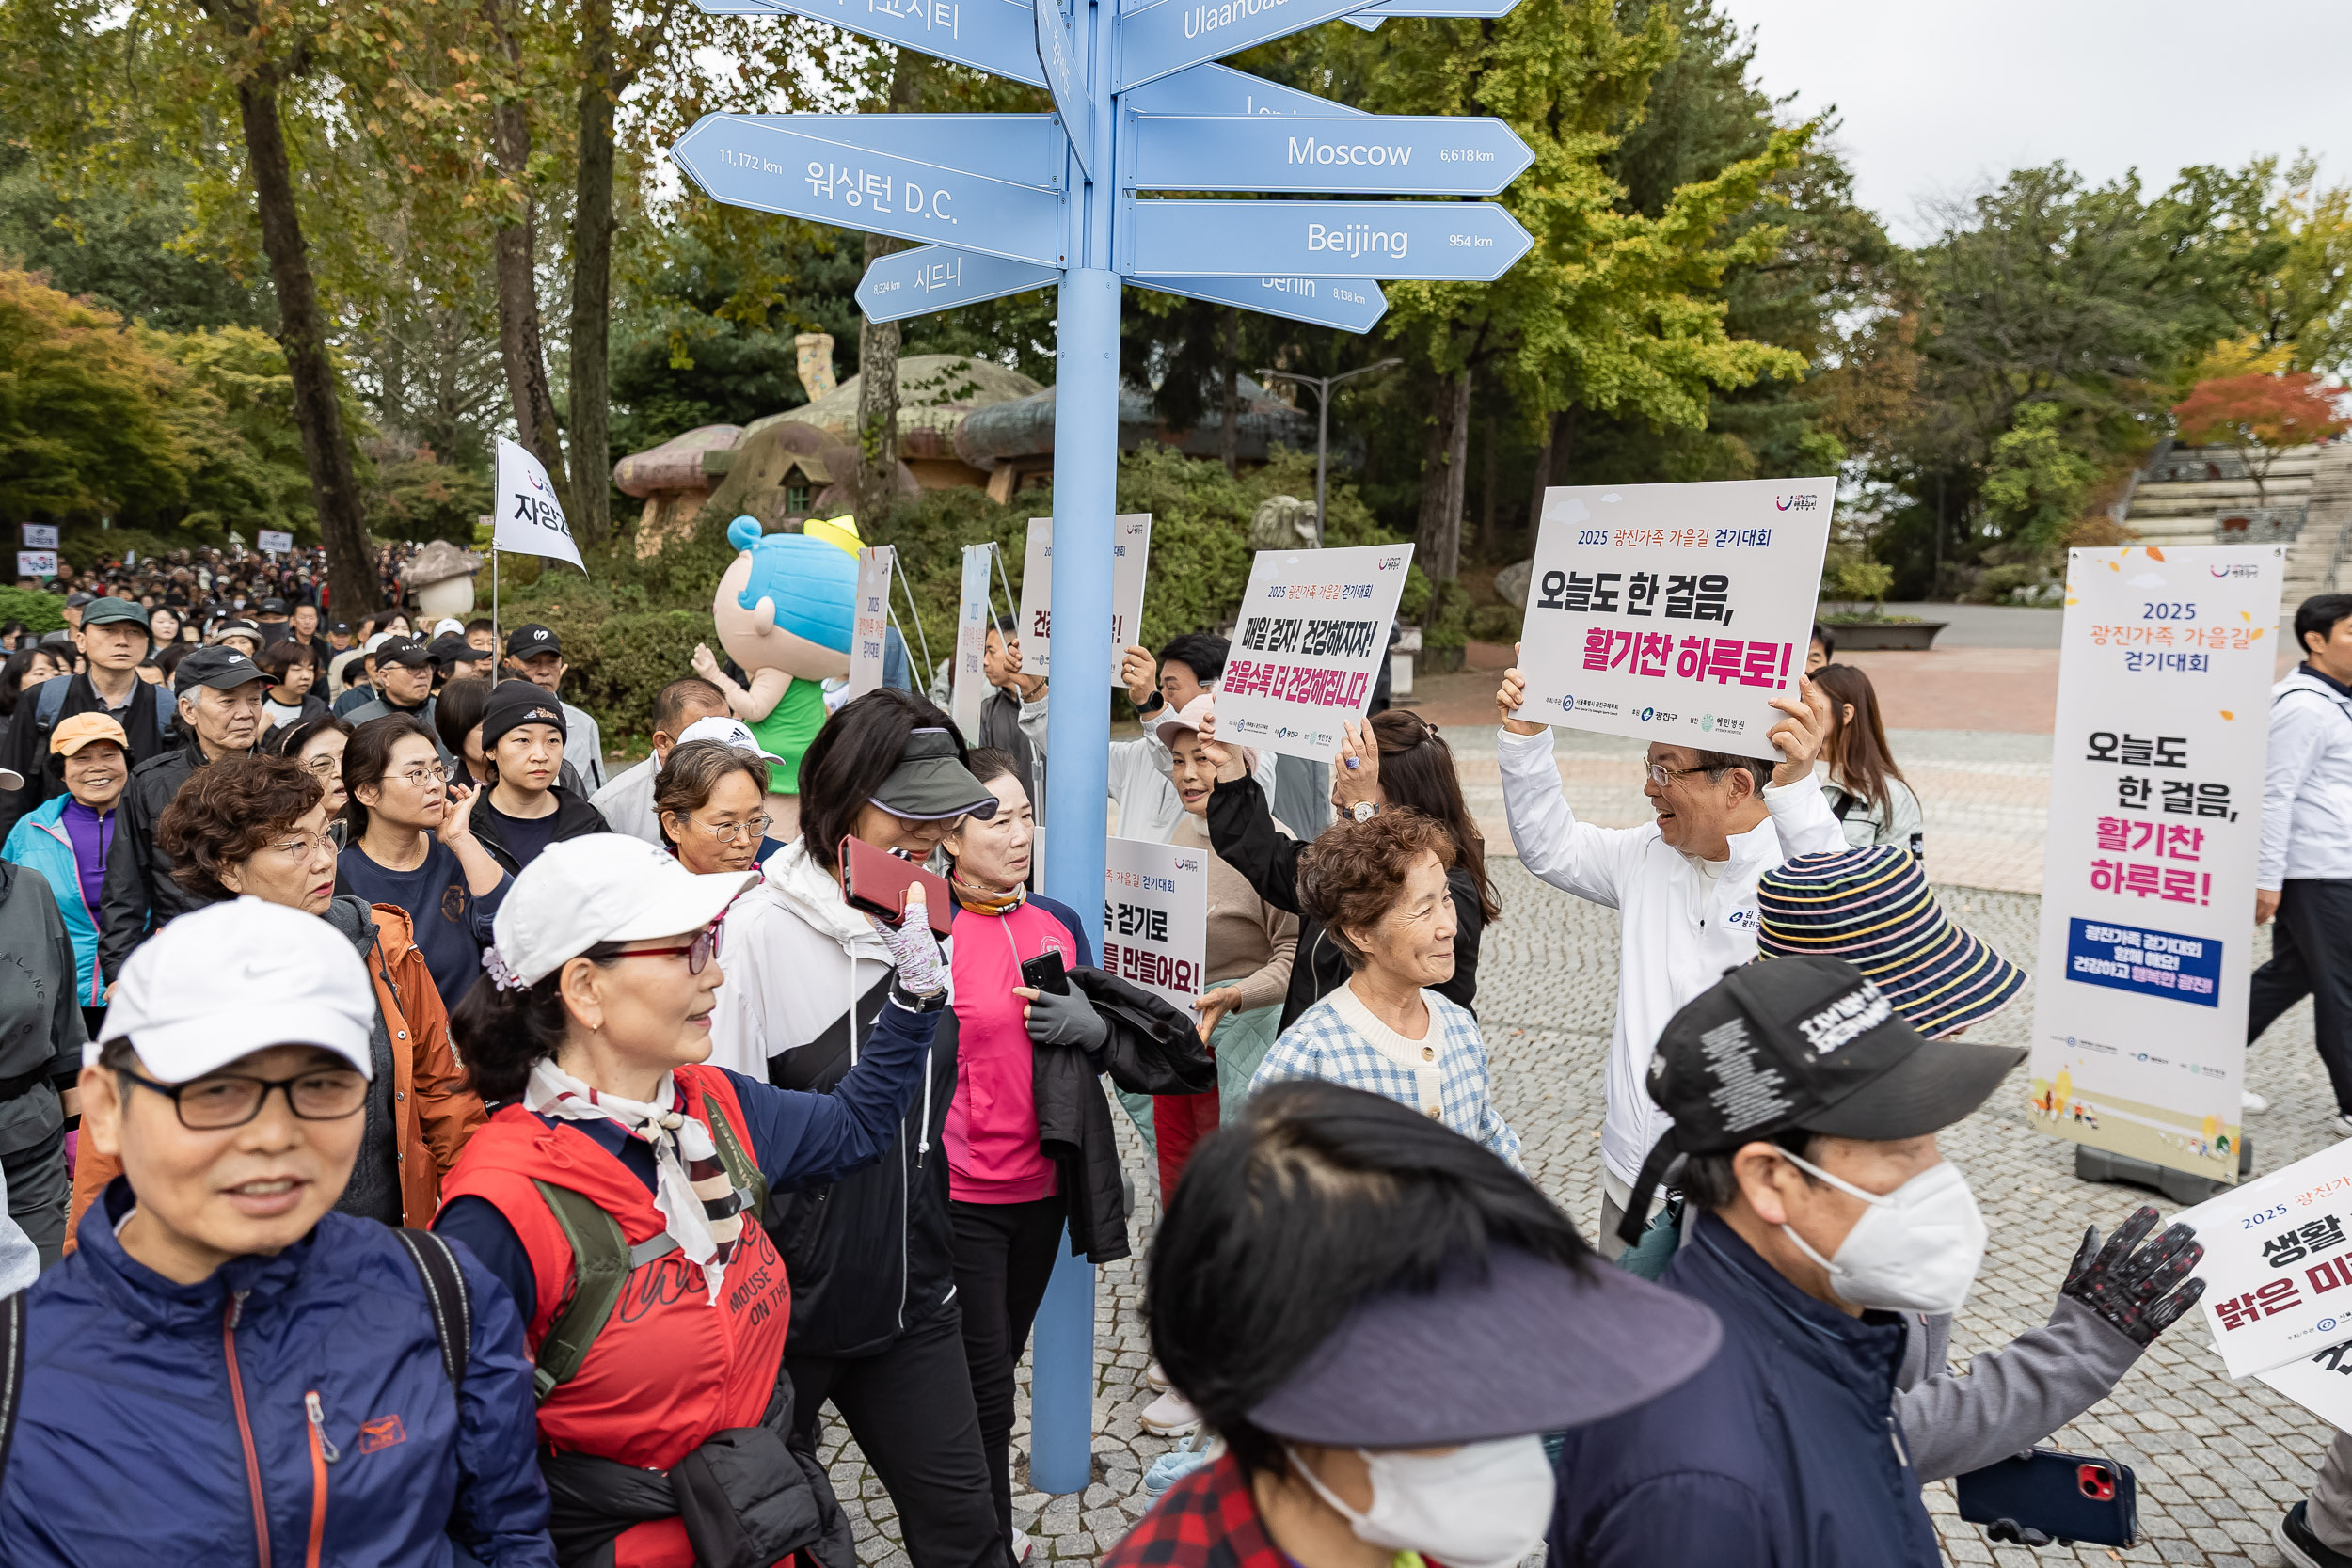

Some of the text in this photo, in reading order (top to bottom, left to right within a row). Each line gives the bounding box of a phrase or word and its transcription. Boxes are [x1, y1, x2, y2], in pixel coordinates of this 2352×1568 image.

[719, 148, 783, 175] 11,172 km
[1287, 136, 1412, 166] Moscow
[804, 161, 958, 225] 워싱턴 D.C.
[1307, 223, 1408, 259] Beijing
[1449, 234, 1493, 247] 954 km
[873, 280, 901, 295] 8,324 km
[914, 257, 961, 294] 시드니
[1332, 288, 1366, 305] 8,138 km
[1578, 528, 1772, 548] 2025 광진가족 가을길 걷기대회
[1268, 584, 1374, 600] 2025 광진가족 가을길 걷기대회
[1536, 570, 1735, 626] 오늘도 한 걸음,
[2143, 603, 2197, 620] 2025
[1242, 617, 1379, 657] 매일 걷자! 건강해지자!
[2090, 625, 2251, 649] 광진가족 가을길
[1582, 627, 1793, 689] 활기찬 하루로!
[2124, 651, 2209, 673] 걷기대회
[1223, 660, 1370, 710] 걸을수록 더 건강해집니다
[1655, 711, 1677, 722] 광진구
[1716, 717, 1745, 730] 혜민병원
[2085, 731, 2187, 768] 오늘도
[2118, 776, 2239, 823] 한 걸음,
[2096, 816, 2204, 862] 활기찬
[1116, 872, 1140, 888] 가을길
[1143, 876, 1175, 894] 걷기대회
[2090, 859, 2212, 906] 하루로!
[1118, 903, 1168, 943] 걷기로
[0, 951, 45, 1012] ALANCE
[1123, 946, 1200, 996] 만들어요!
[2241, 1203, 2288, 1229] 2025
[2262, 1214, 2347, 1269] 생활
[729, 1265, 772, 1315] MOUSE
[750, 1279, 788, 1326] ON THE
[2215, 1252, 2352, 1332] 밝은 미
